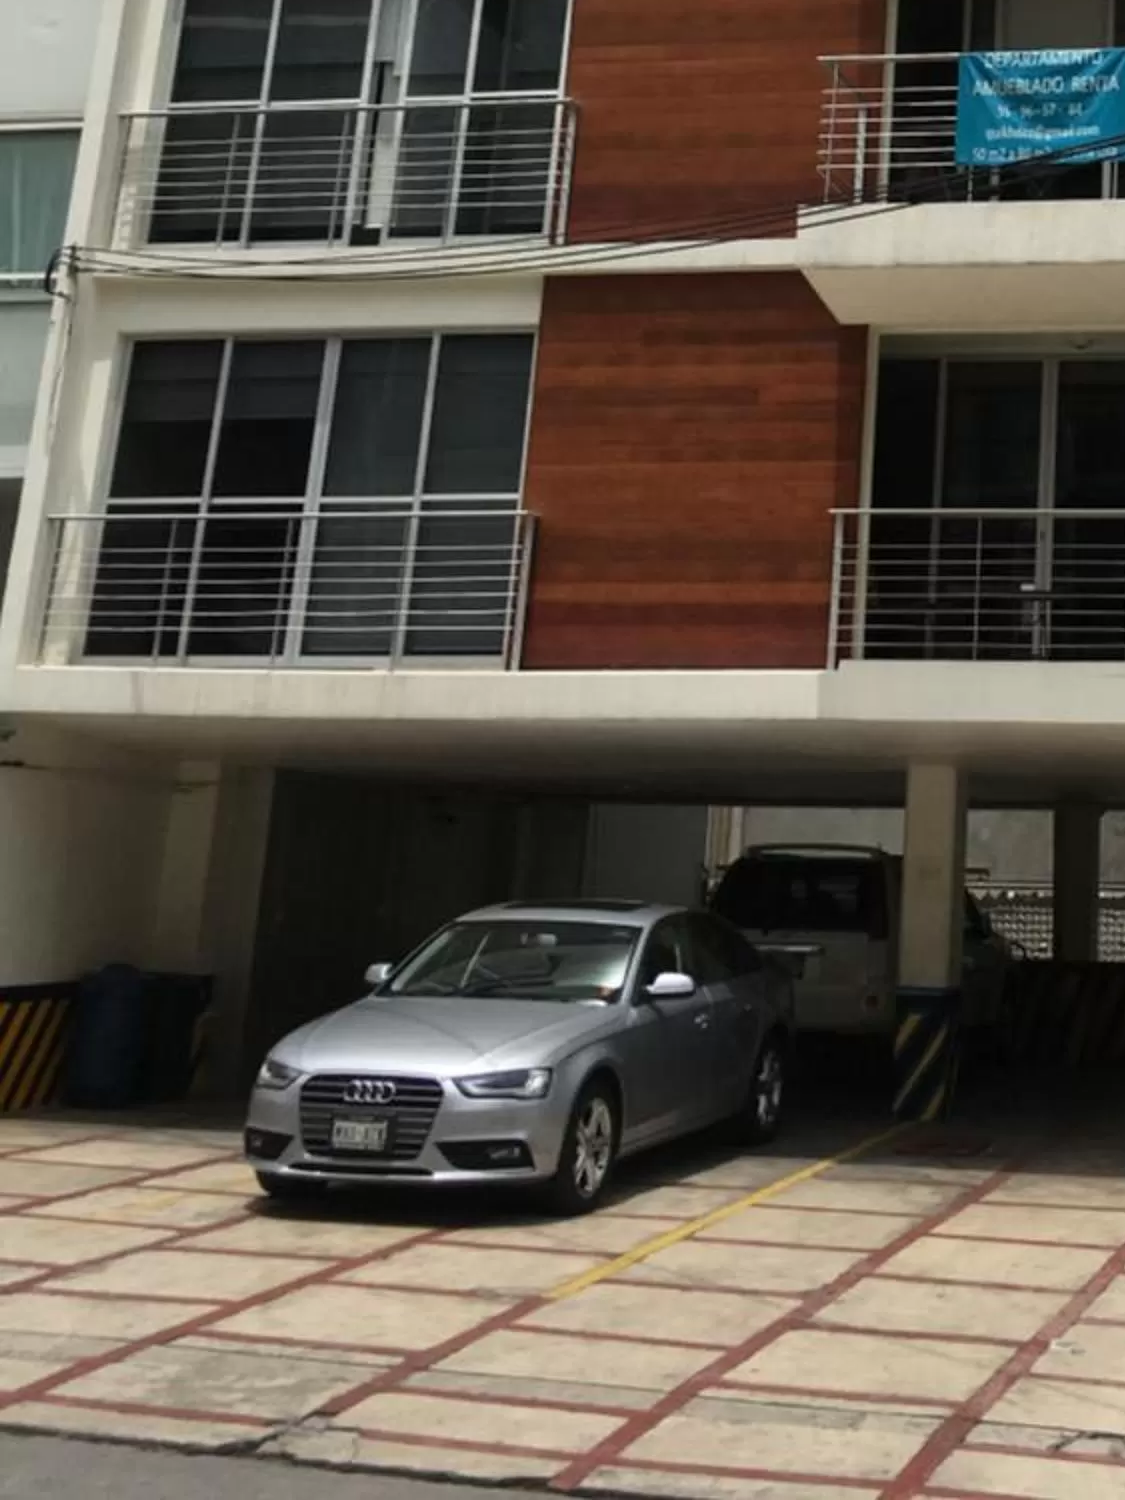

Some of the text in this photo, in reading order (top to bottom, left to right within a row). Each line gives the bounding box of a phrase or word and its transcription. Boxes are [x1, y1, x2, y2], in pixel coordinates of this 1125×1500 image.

[984, 51, 1103, 68] DEPARTAMENTO
[973, 75, 1120, 96] AMUEBLADO RENTA
